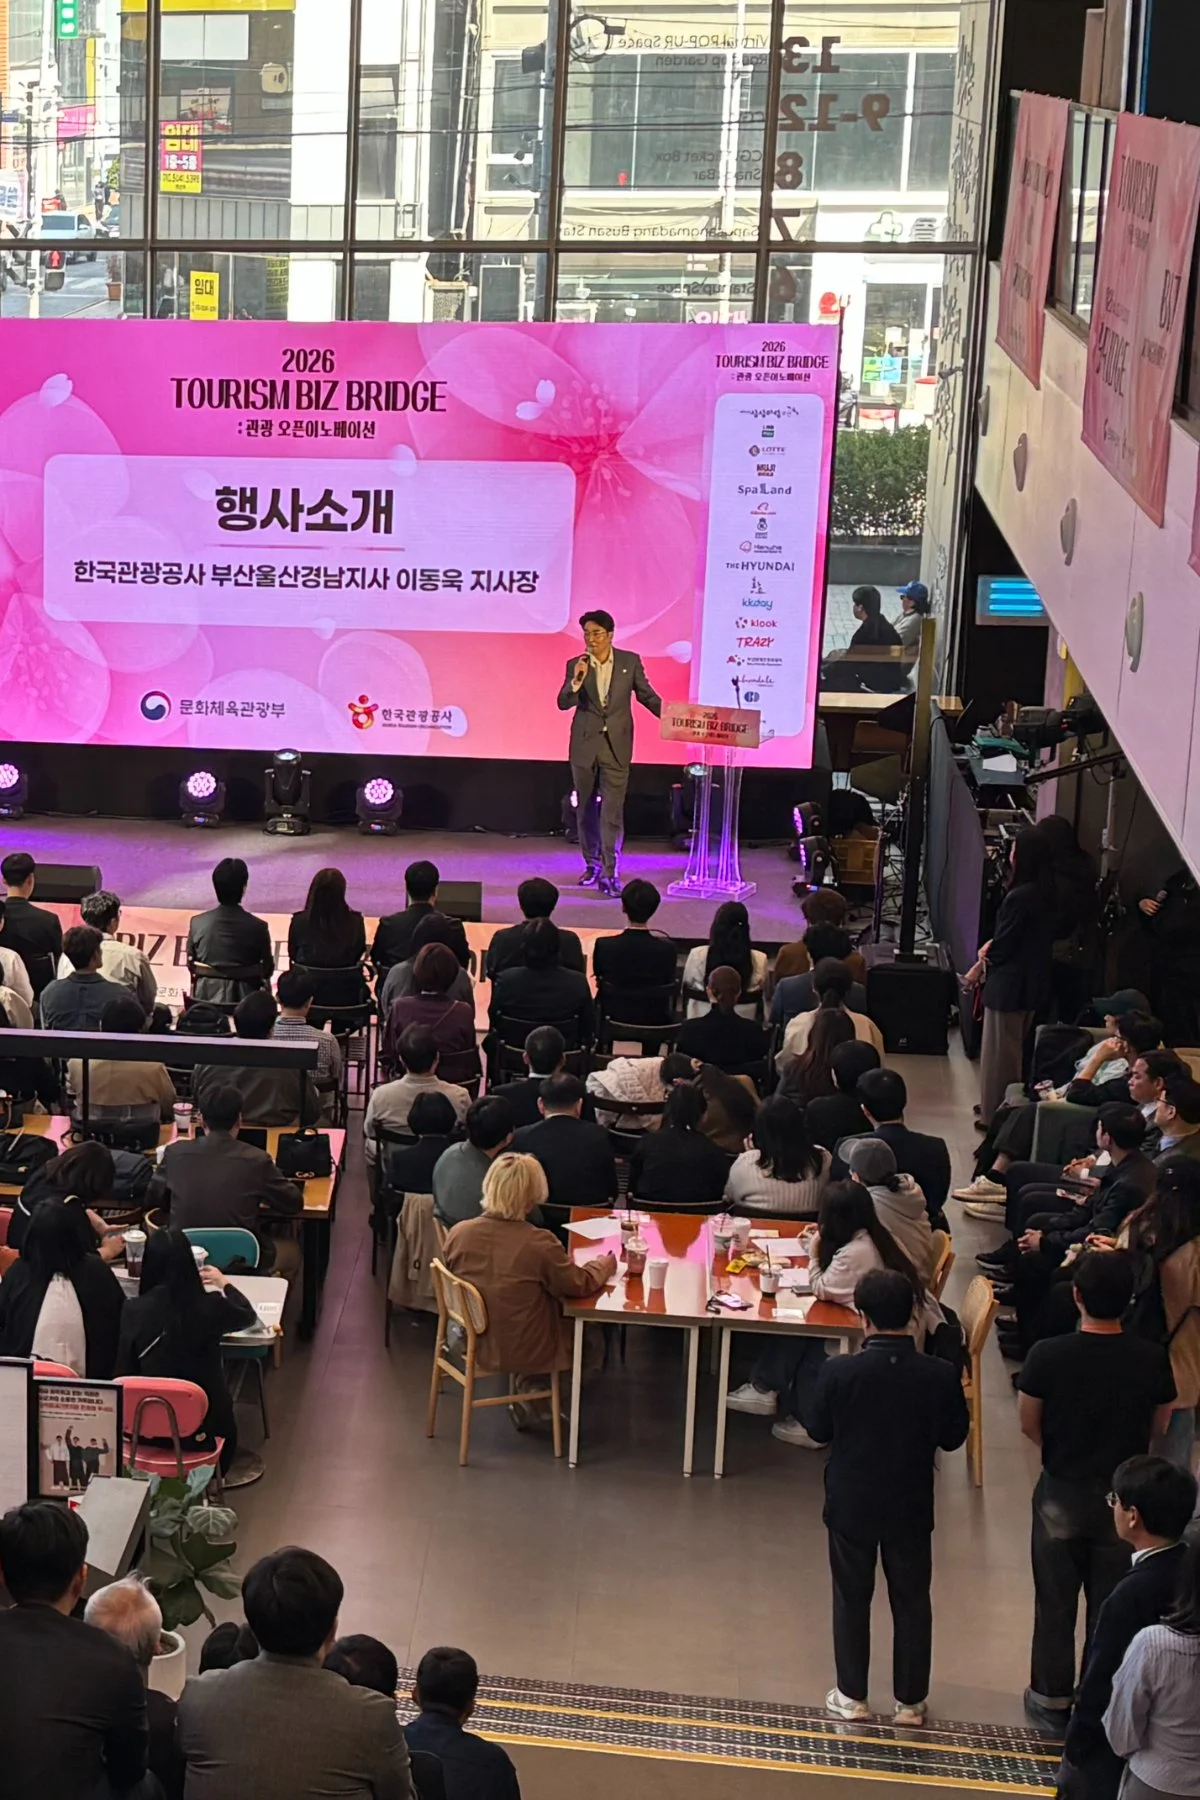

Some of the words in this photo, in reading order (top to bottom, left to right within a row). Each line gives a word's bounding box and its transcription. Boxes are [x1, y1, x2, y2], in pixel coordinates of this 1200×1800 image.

[165, 124, 199, 151] 임대
[194, 278, 214, 296] 임대
[762, 341, 786, 352] 2026
[281, 348, 335, 373] 2026
[715, 355, 766, 368] TOURISM
[767, 355, 785, 369] BIZ
[787, 356, 829, 369] BRIDGE
[170, 377, 290, 410] TOURISM
[295, 380, 339, 411] BIZ
[346, 381, 448, 412] BRIDGE
[277, 420, 376, 439] 오픈이노베이션
[215, 486, 394, 535] 행사소개
[726, 562, 740, 570] THE
[741, 561, 795, 571] HYUNDAI
[73, 560, 205, 587] 한국관광공사
[211, 563, 390, 591] 부산울산경남지사
[396, 567, 463, 594] 이동욱
[470, 569, 540, 596] 지사장
[742, 598, 773, 611] kkday
[750, 619, 777, 628] klook
[736, 636, 775, 648] TRAZY
[179, 699, 285, 718] 문화체육관광부
[382, 708, 452, 723] 한국관광공사
